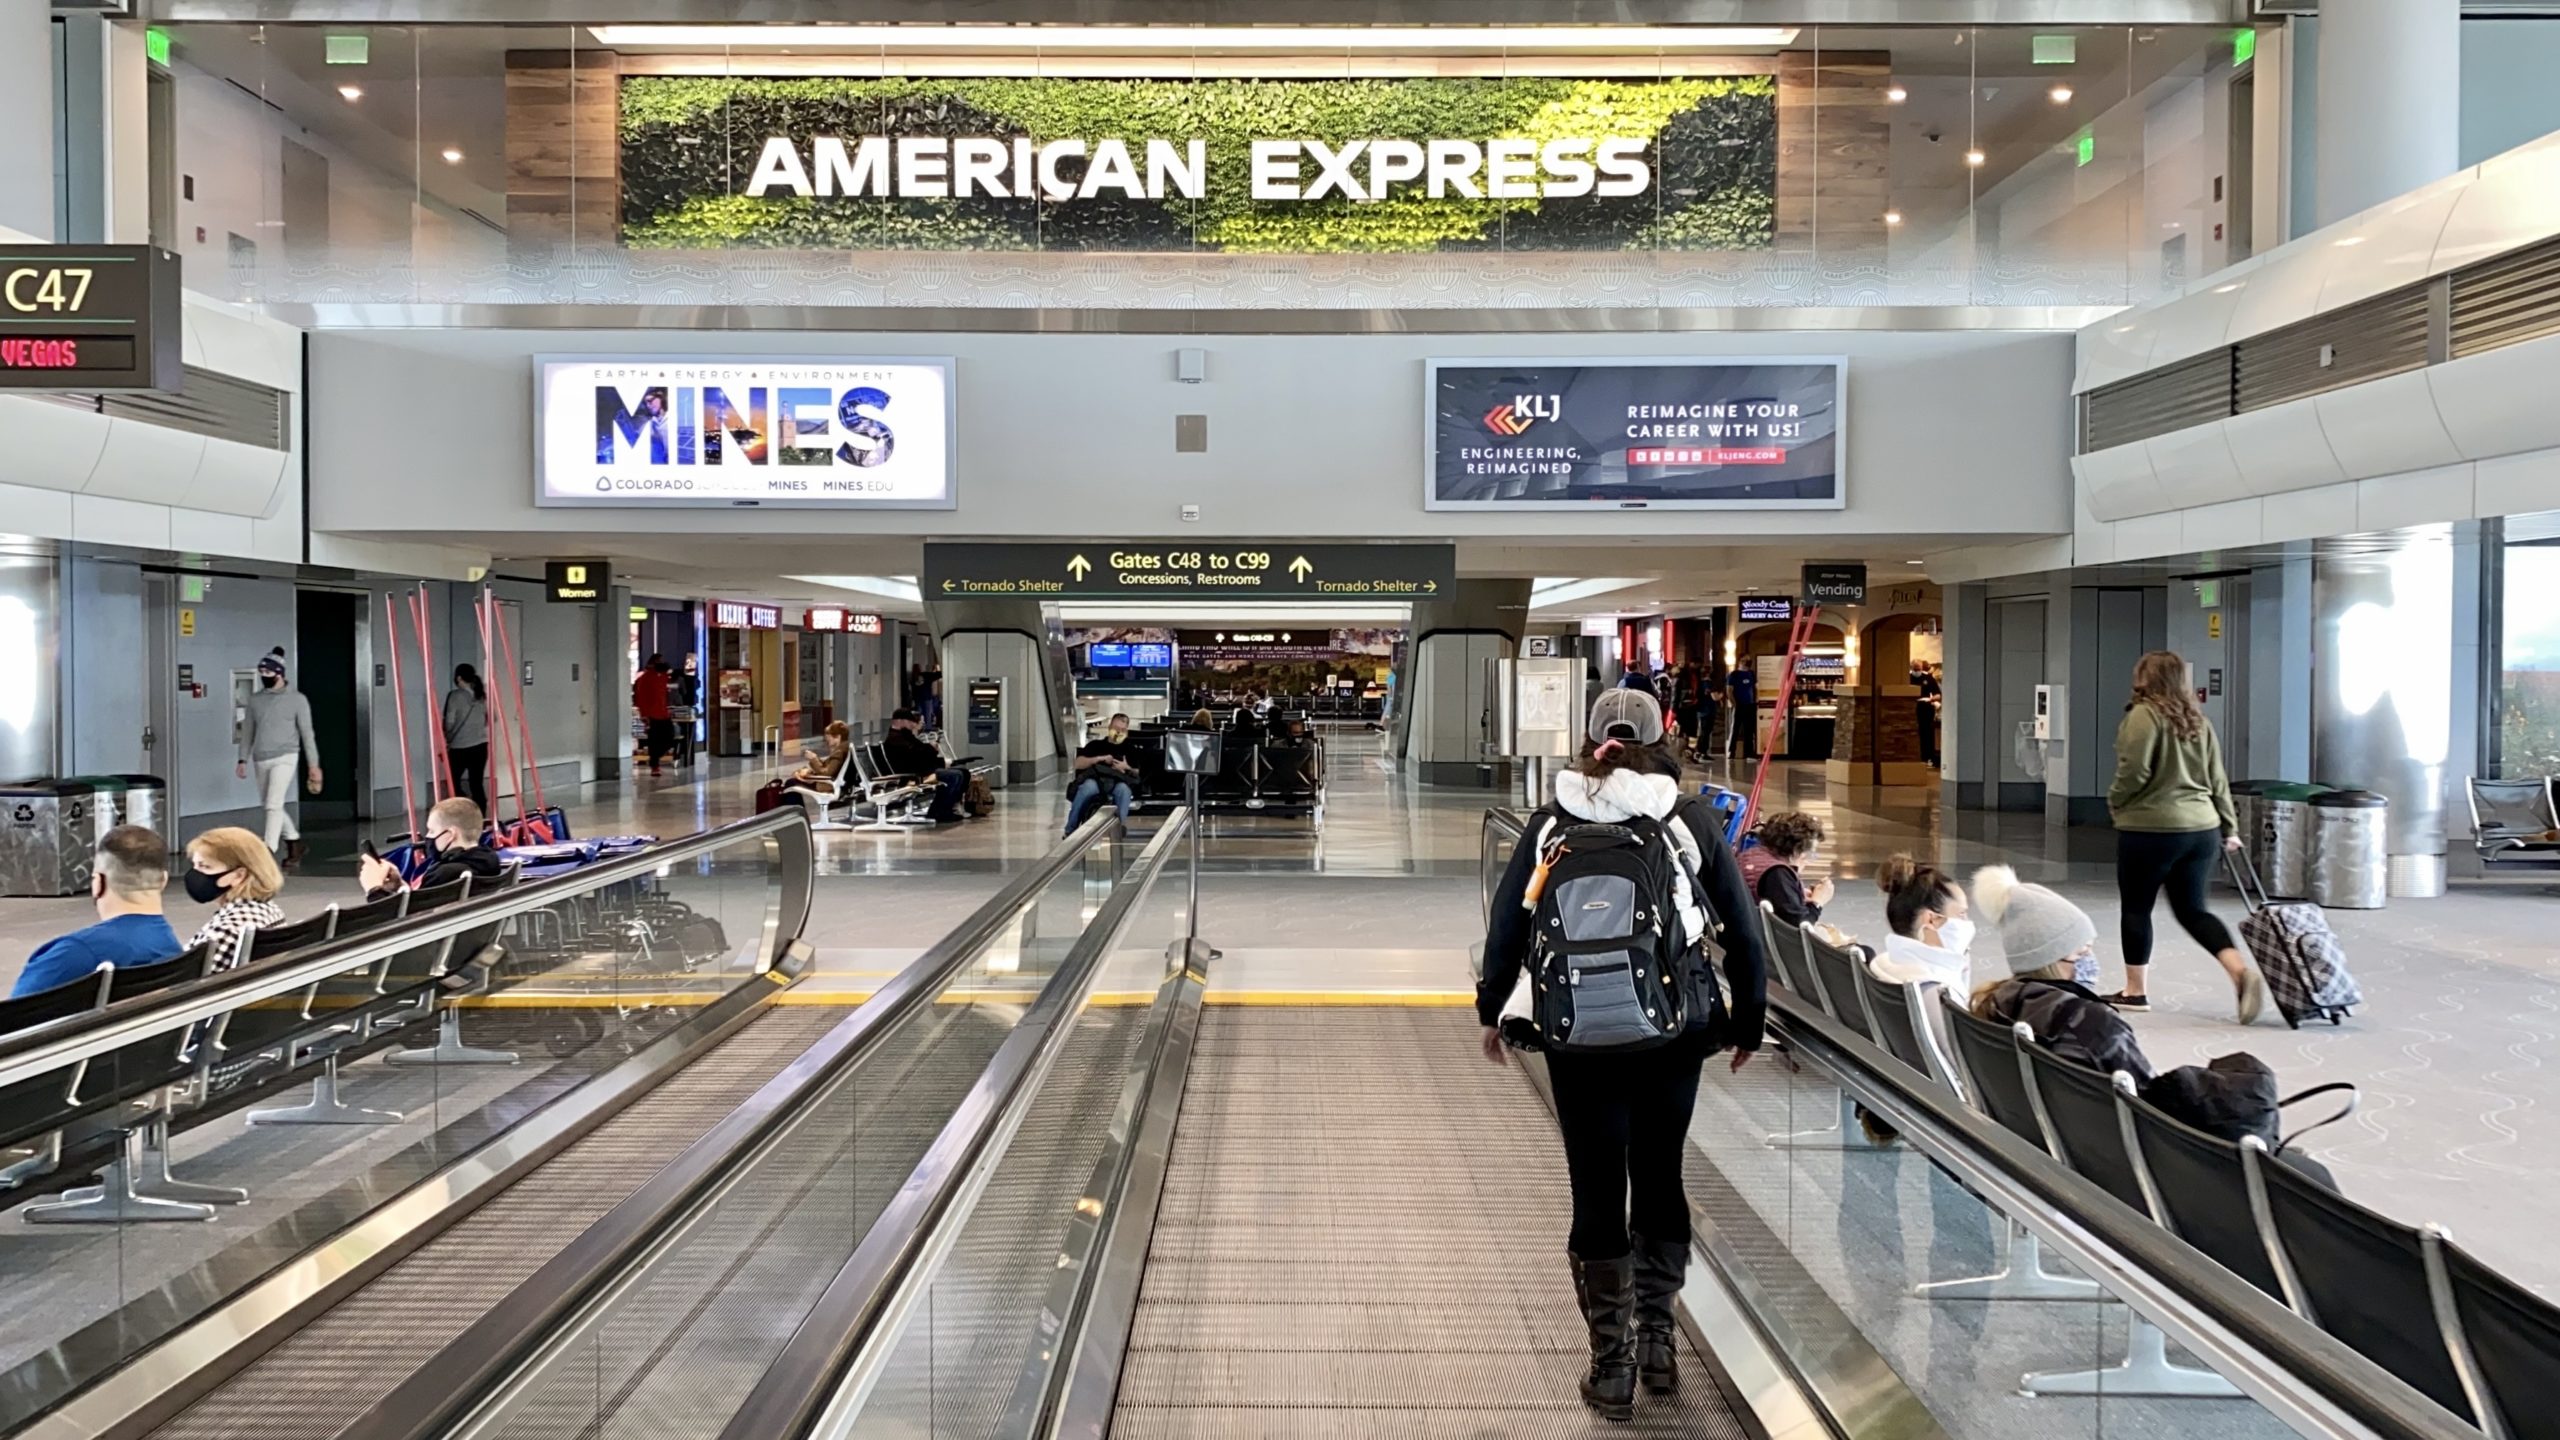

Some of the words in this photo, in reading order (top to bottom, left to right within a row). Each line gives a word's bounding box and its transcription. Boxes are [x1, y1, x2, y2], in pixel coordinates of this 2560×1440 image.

[746, 137, 1207, 201] AMERICAN
[1251, 136, 1651, 199] EXPRESS
[5, 268, 93, 312] C47
[1, 339, 77, 367] VEGAS
[594, 369, 649, 379] EARTH
[675, 370, 742, 379] ENERGY
[769, 371, 894, 380] ENVIRONMENT
[1514, 395, 1560, 422] KLJ
[1628, 404, 1738, 419] REIMAGINE
[1745, 404, 1800, 418] YOUR
[595, 386, 895, 468] MINES
[1626, 423, 1700, 438] CAREER
[1707, 423, 1759, 438] WITH
[1767, 423, 1801, 438] US!
[1461, 447, 1581, 461] ENGINEERING,
[1467, 462, 1572, 475] REIMAGINED
[615, 479, 694, 490] COLORADO
[768, 480, 808, 491] MINES
[1109, 551, 1161, 569] Gates
[1167, 551, 1201, 569] C48
[1209, 553, 1229, 569] to
[1235, 551, 1270, 569] C99
[961, 579, 1015, 592] Tornado
[1018, 579, 1064, 592] Shelter
[1118, 571, 1192, 587] Concessions,
[1197, 572, 1262, 586] Restrooms
[1316, 579, 1370, 592] Tornado
[1373, 579, 1418, 592] Shelter
[557, 588, 597, 598] Women
[1809, 584, 1862, 599] Vending
[1741, 599, 1768, 609] Woody
[1769, 600, 1790, 609] Creek
[752, 607, 777, 628] COFFEE
[848, 615, 877, 624] VINO
[848, 623, 877, 632] VOLO
